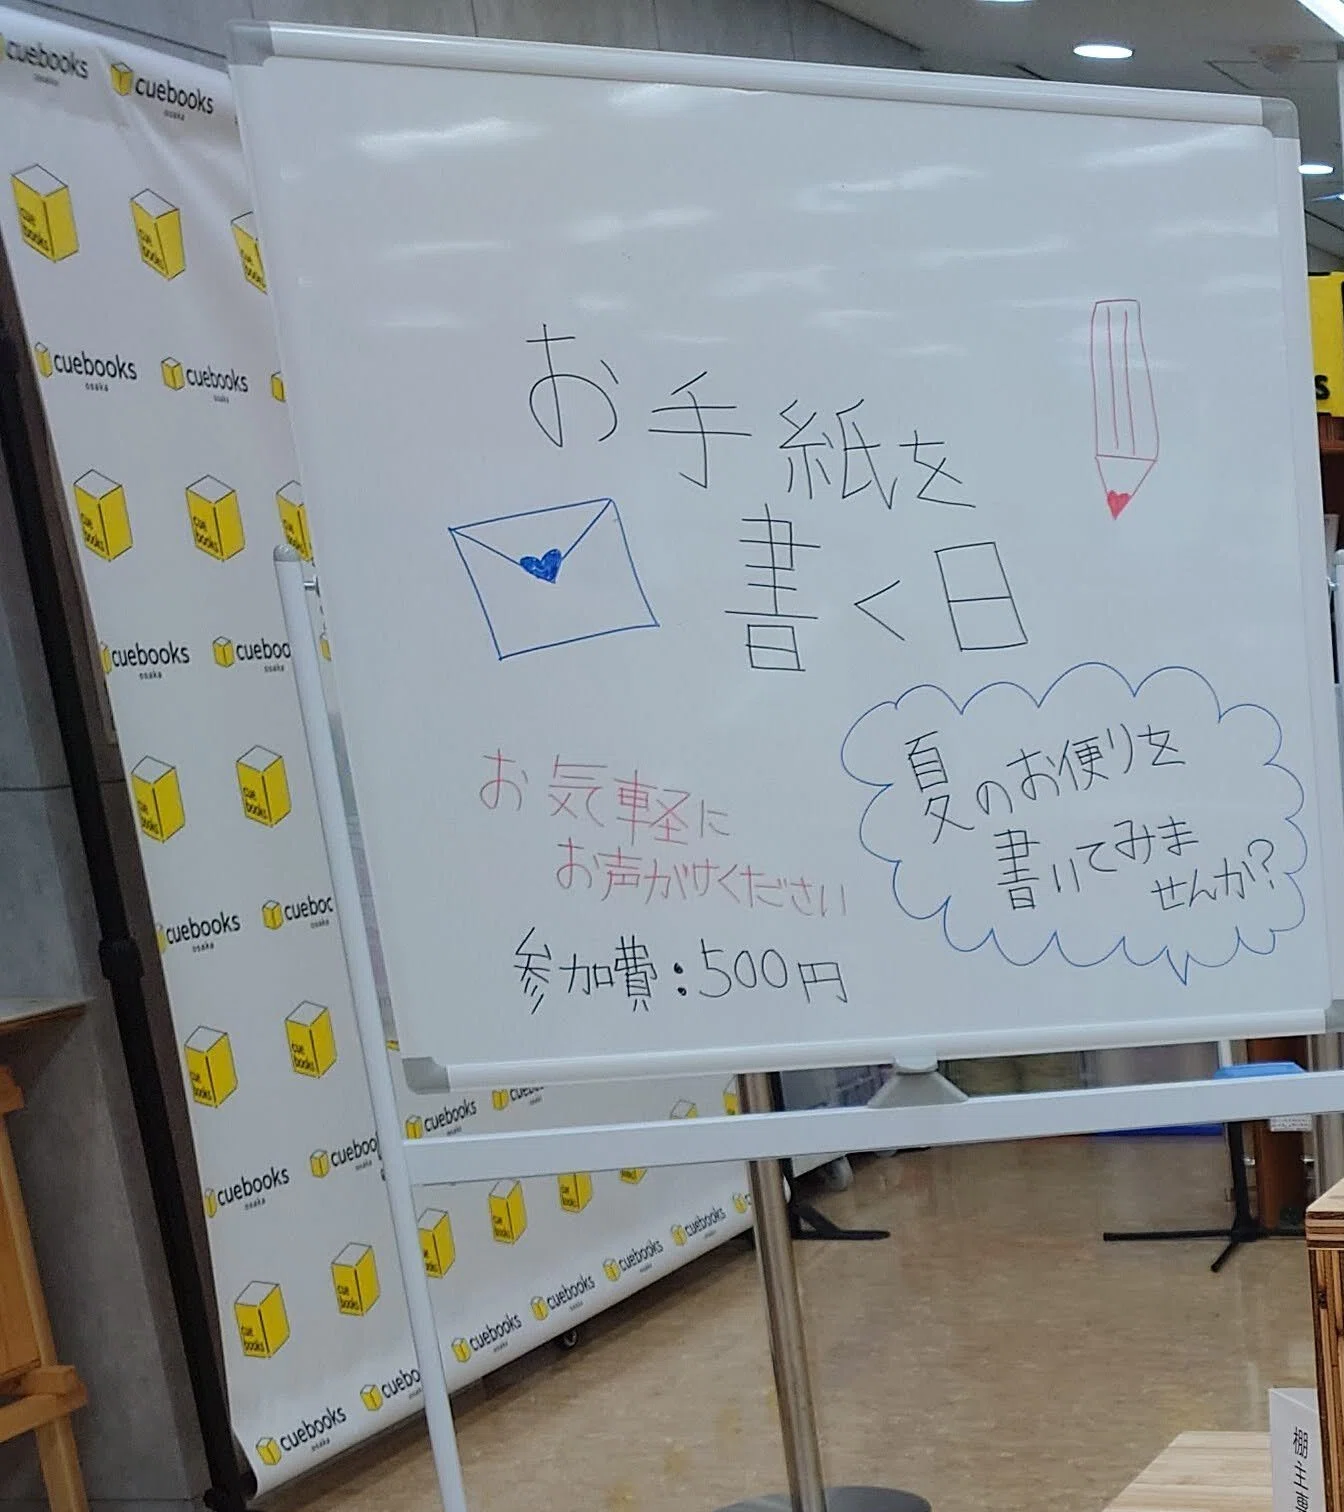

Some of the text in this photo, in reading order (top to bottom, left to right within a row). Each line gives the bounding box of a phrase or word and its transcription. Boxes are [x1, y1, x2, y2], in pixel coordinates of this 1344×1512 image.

[6, 39, 89, 79] cuebooks
[135, 77, 214, 115] cuebooks
[54, 350, 138, 381] cuebooks
[186, 364, 249, 393] cuebooks
[527, 324, 977, 510] お手紙を
[725, 503, 1029, 673] 書く日
[111, 641, 190, 667] cuebooks
[237, 639, 291, 661] cueboo
[479, 750, 730, 847] お気軽に
[906, 722, 1187, 845] 夏のお便りを
[555, 839, 848, 918] お声がけください
[995, 816, 1199, 911] 書いてみま
[284, 895, 334, 921] cueboo
[166, 912, 241, 945] cuebooks
[424, 1098, 477, 1133] cuebooks
[331, 1136, 377, 1168] cueboo
[217, 1166, 290, 1207] cuebooks
[684, 1206, 727, 1239] cuebooks
[618, 1239, 664, 1274] cuebooks
[546, 1274, 595, 1312] cuebooks
[469, 1312, 522, 1353] cuebooks
[382, 1368, 421, 1399] cuebo
[280, 1406, 347, 1452] cuebooks
